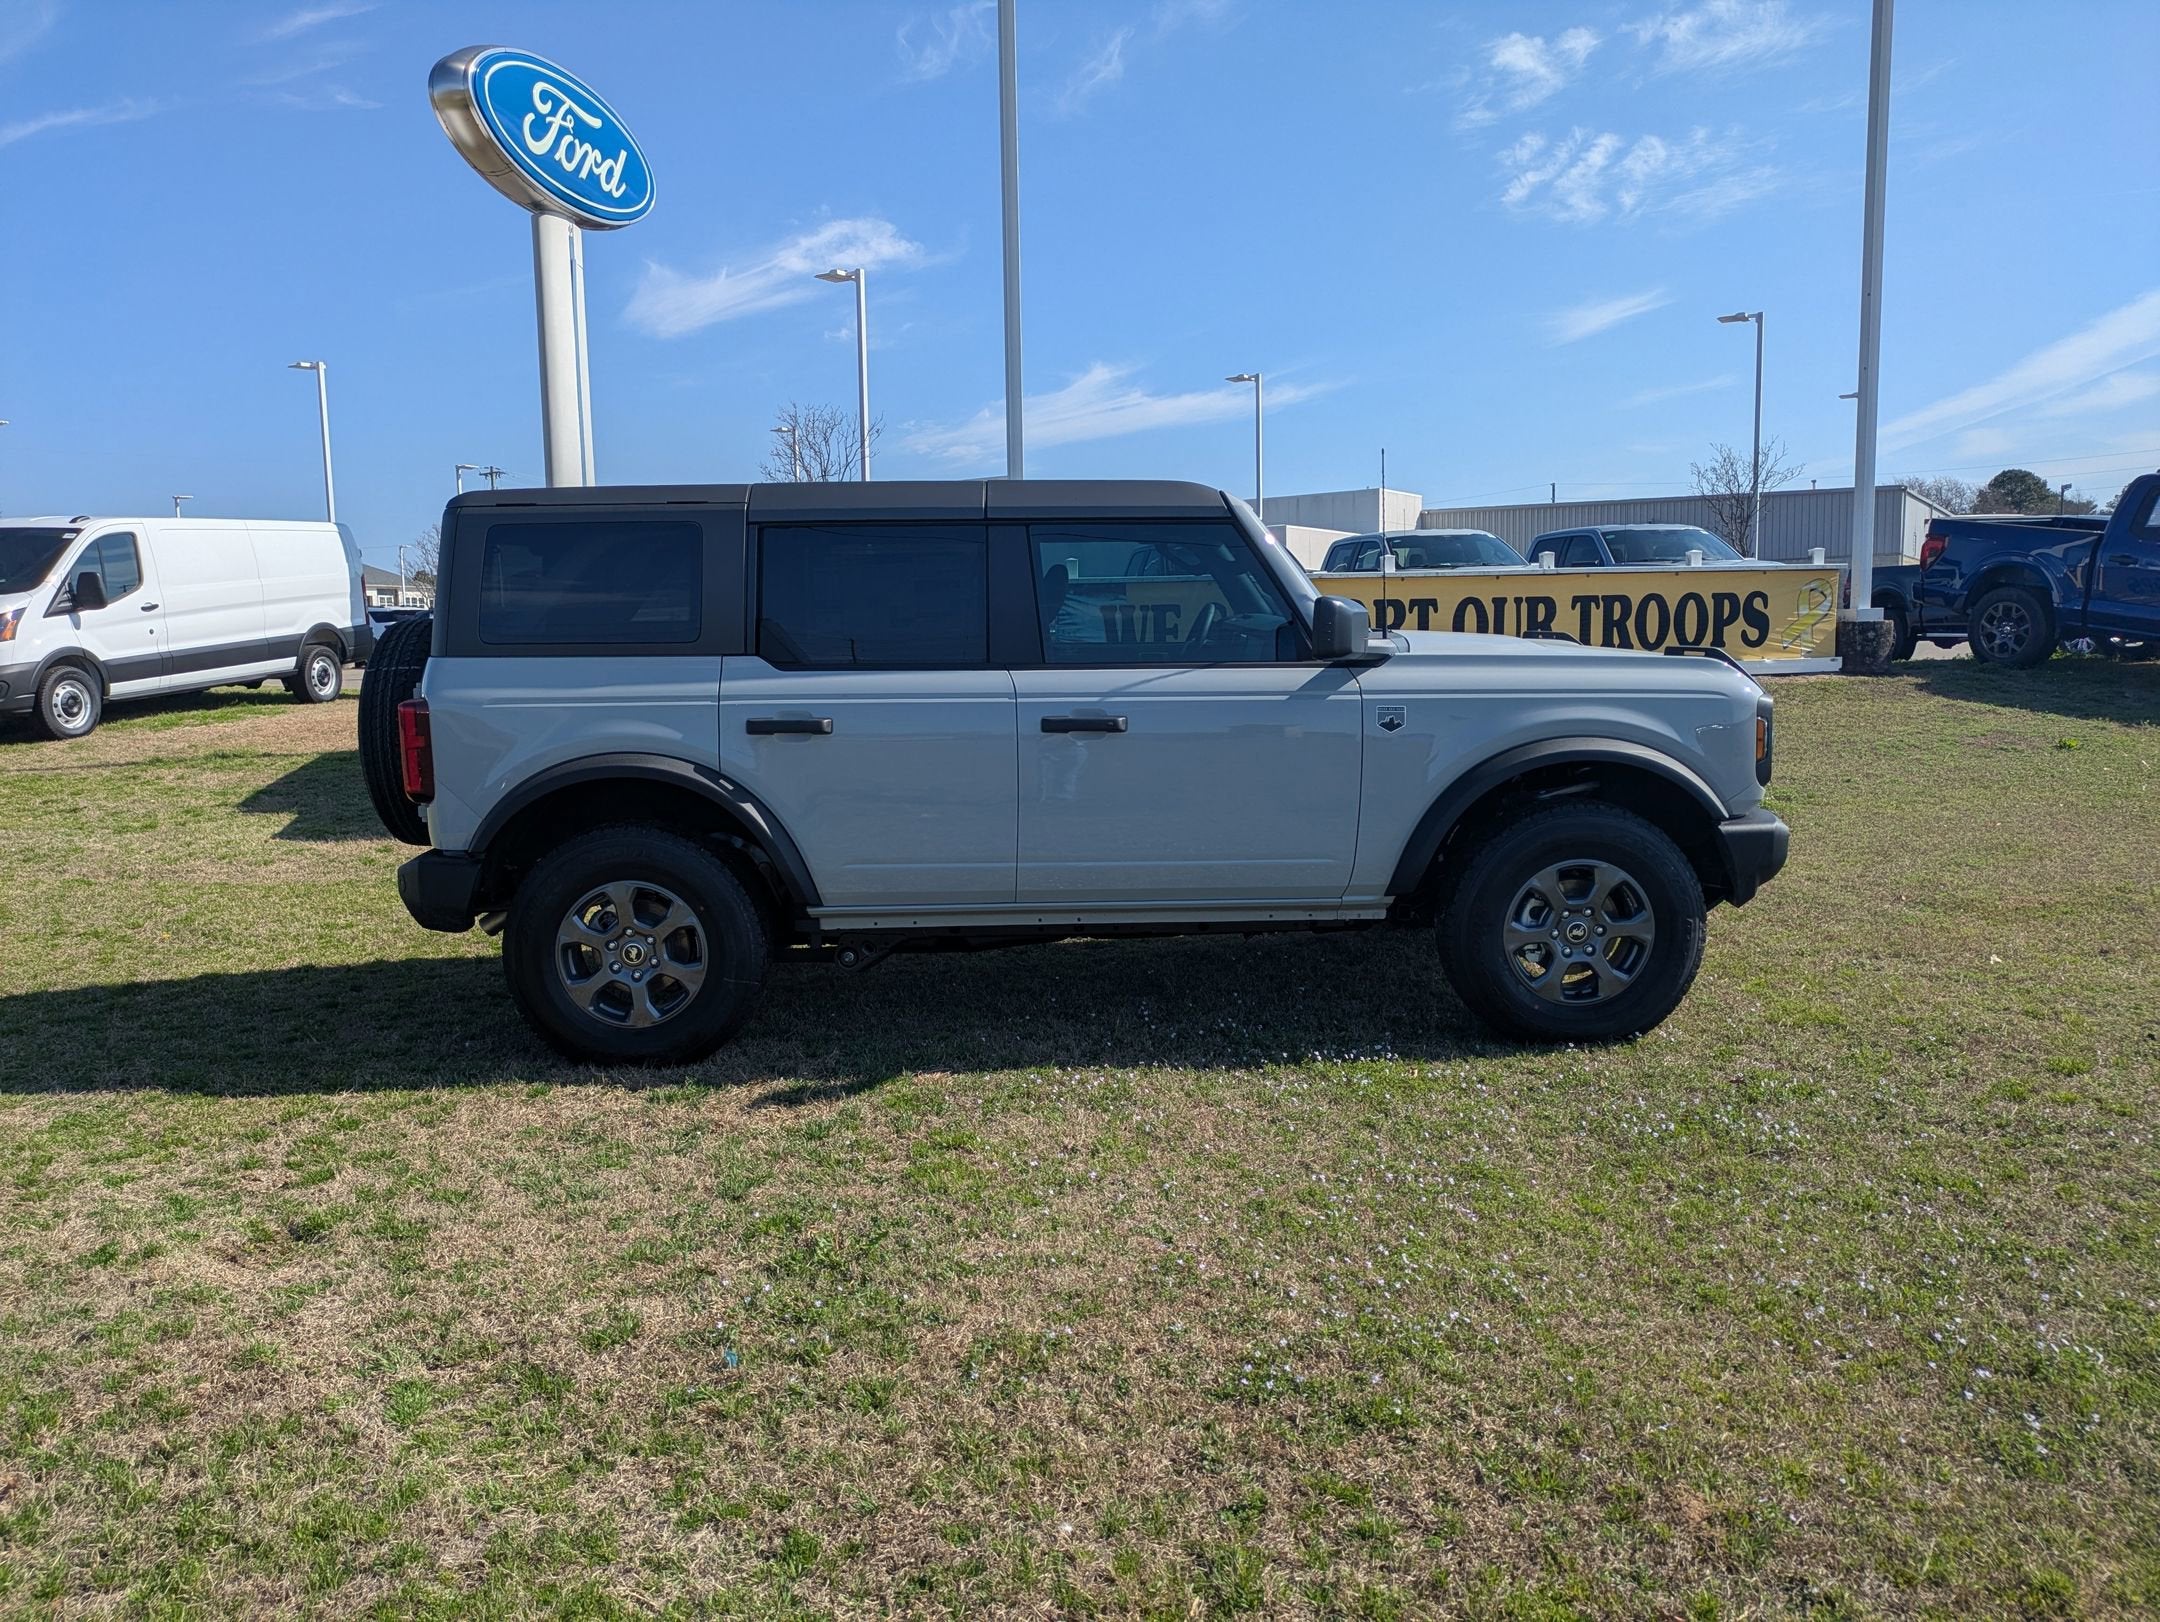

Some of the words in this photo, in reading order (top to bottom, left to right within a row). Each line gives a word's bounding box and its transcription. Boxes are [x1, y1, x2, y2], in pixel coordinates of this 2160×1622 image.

[523, 81, 627, 199] Ford
[1099, 603, 1182, 645] WE
[1452, 595, 1558, 638] OUR
[1570, 590, 1771, 652] TROOPS
